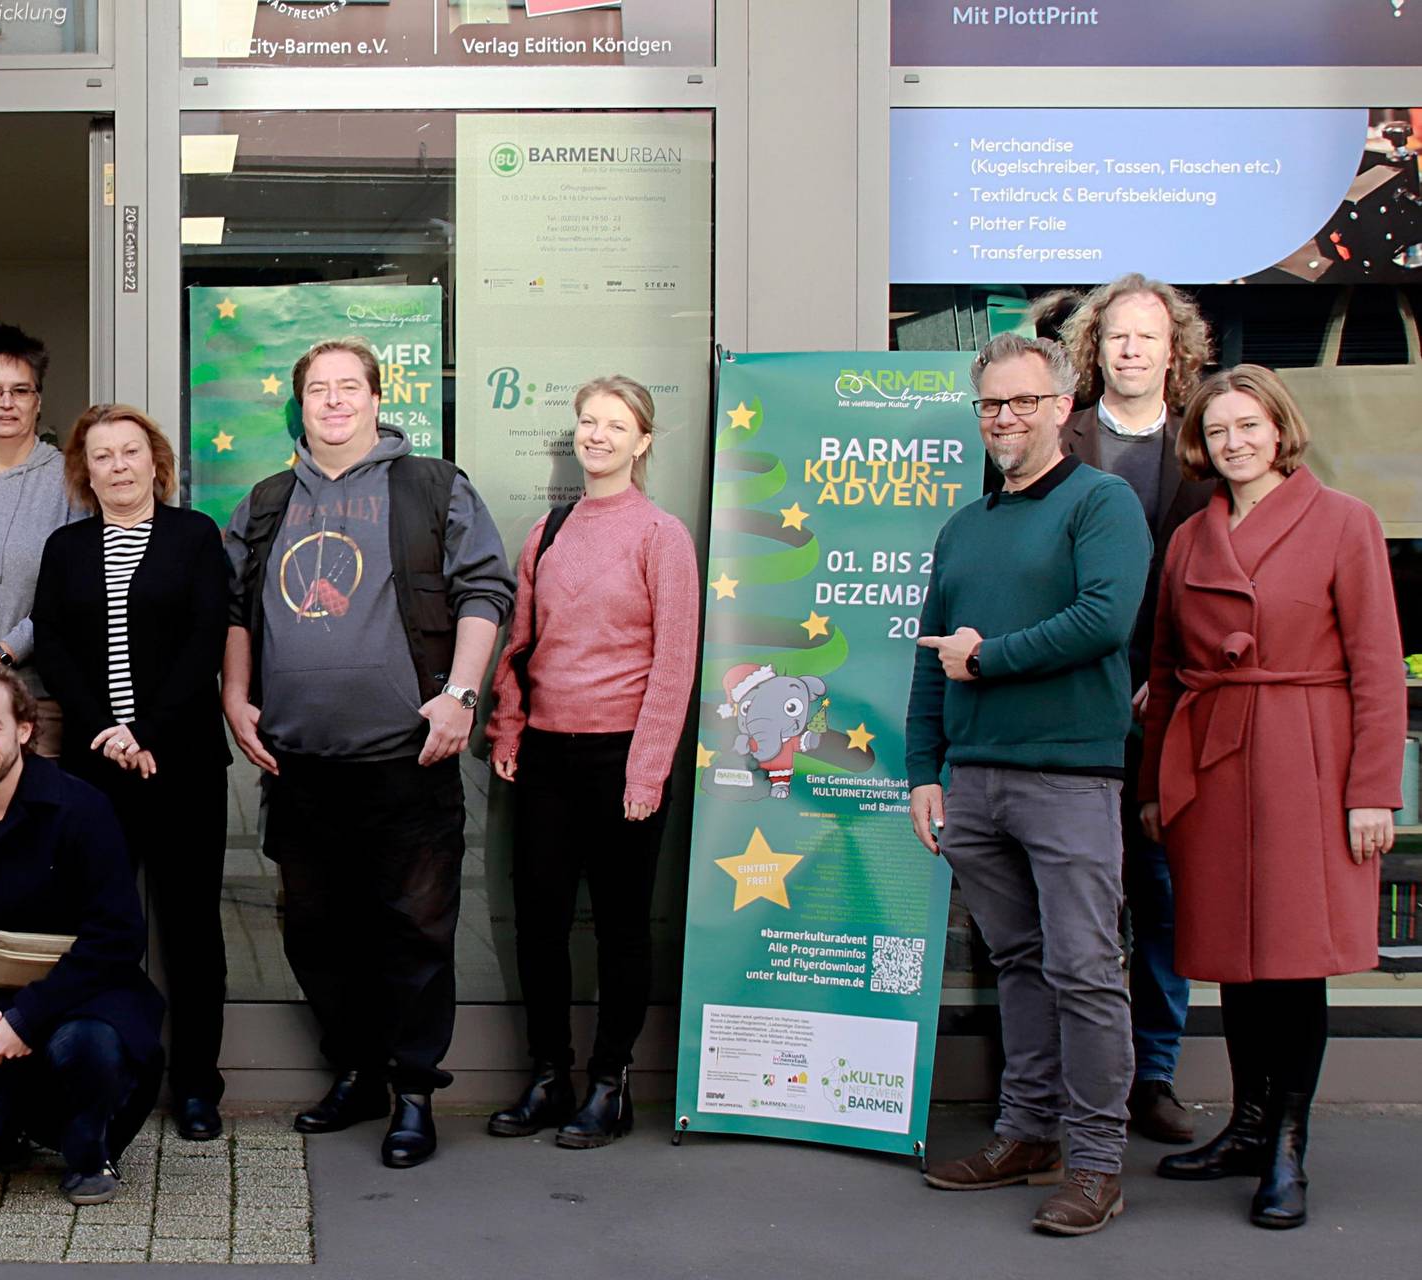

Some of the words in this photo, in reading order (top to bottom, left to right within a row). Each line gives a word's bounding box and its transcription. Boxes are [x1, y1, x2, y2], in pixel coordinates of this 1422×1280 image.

[267, 0, 339, 20] ADTRECHTE
[952, 7, 989, 25] Mit
[994, 6, 1098, 25] PlottPrint
[249, 38, 352, 58] City-Barmen
[357, 39, 389, 54] e.V.
[462, 38, 519, 57] Verlag
[524, 37, 586, 54] Edition
[592, 36, 672, 57] Köndgen
[970, 137, 1074, 153] Merchandise
[528, 147, 682, 163] BARMENURBAN
[970, 158, 1100, 177] (Kugelschreiber,
[1104, 159, 1165, 176] Tassen,
[1169, 158, 1240, 175] Flaschen
[1244, 158, 1282, 177] etc.)
[969, 187, 1058, 203] Textildruck
[1062, 188, 1075, 203] &
[1077, 187, 1217, 205] Berufsbekleidung
[969, 216, 1025, 231] Plotter
[1028, 216, 1067, 231] Folie
[969, 244, 1102, 262] Transferpressen
[371, 343, 432, 365] MER
[839, 369, 955, 392] BARMEN
[380, 383, 432, 404] ENT
[544, 399, 570, 407] www.
[838, 400, 850, 408] Mit
[888, 401, 910, 409] Kultur
[820, 437, 963, 464] BARMER
[804, 459, 946, 485] KULTUR-
[817, 481, 963, 507] ADVENT
[826, 550, 863, 573] 01.
[871, 551, 912, 574] BIS
[919, 552, 934, 574] 2
[888, 616, 920, 639] 20
[806, 774, 826, 784] Eine
[827, 775, 910, 788] Gemeinschaftsakt
[812, 787, 899, 800] KULTURNETZWERK
[859, 802, 877, 812] und
[737, 863, 780, 874] EINTRITT
[760, 928, 868, 945] #barmerkulturadvent
[768, 942, 788, 953] Alle
[790, 944, 866, 959] Programminfos
[770, 957, 791, 967] und
[793, 958, 866, 974] Flyerdownload
[746, 970, 774, 980] unter
[776, 971, 865, 988] kultur-barmen.de
[849, 1070, 904, 1088] KULTUR
[848, 1096, 903, 1114] BARMEN
